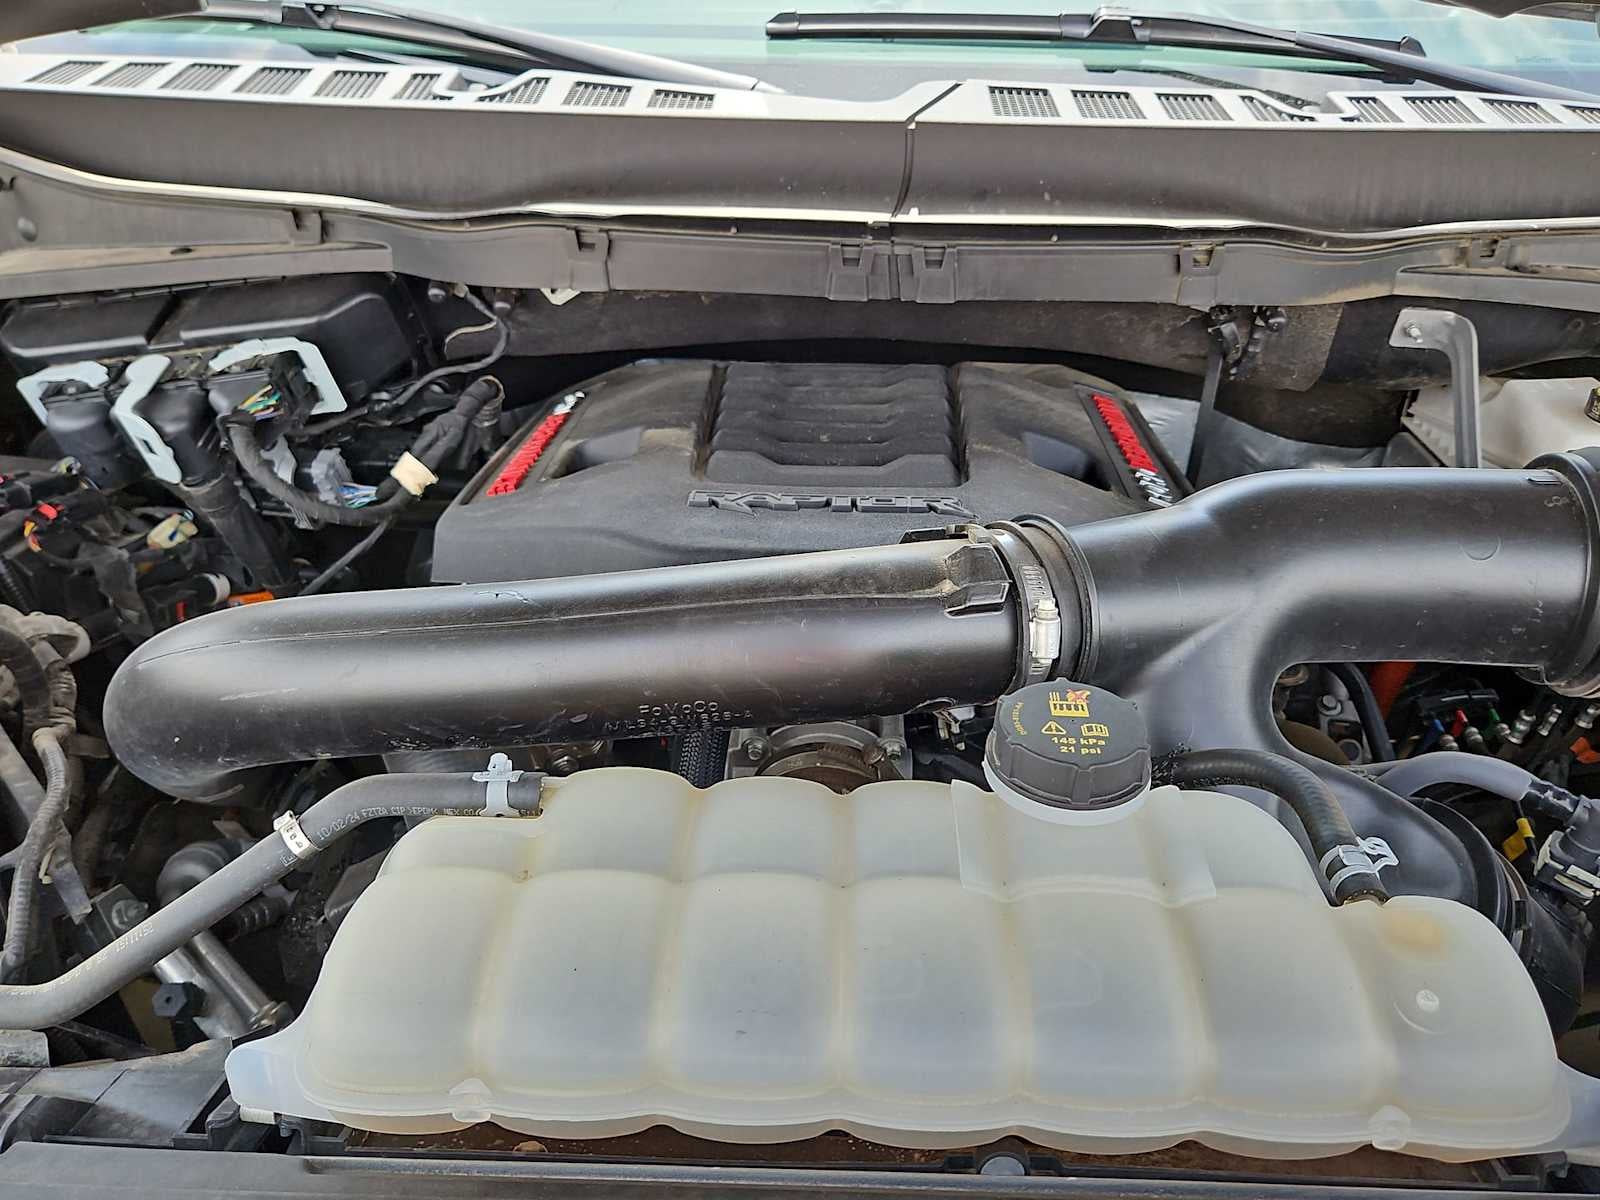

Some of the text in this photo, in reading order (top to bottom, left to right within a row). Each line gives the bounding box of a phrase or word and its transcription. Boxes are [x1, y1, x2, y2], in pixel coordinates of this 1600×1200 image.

[688, 490, 979, 518] RAPTOR
[1051, 736, 1106, 746] 145 kPa
